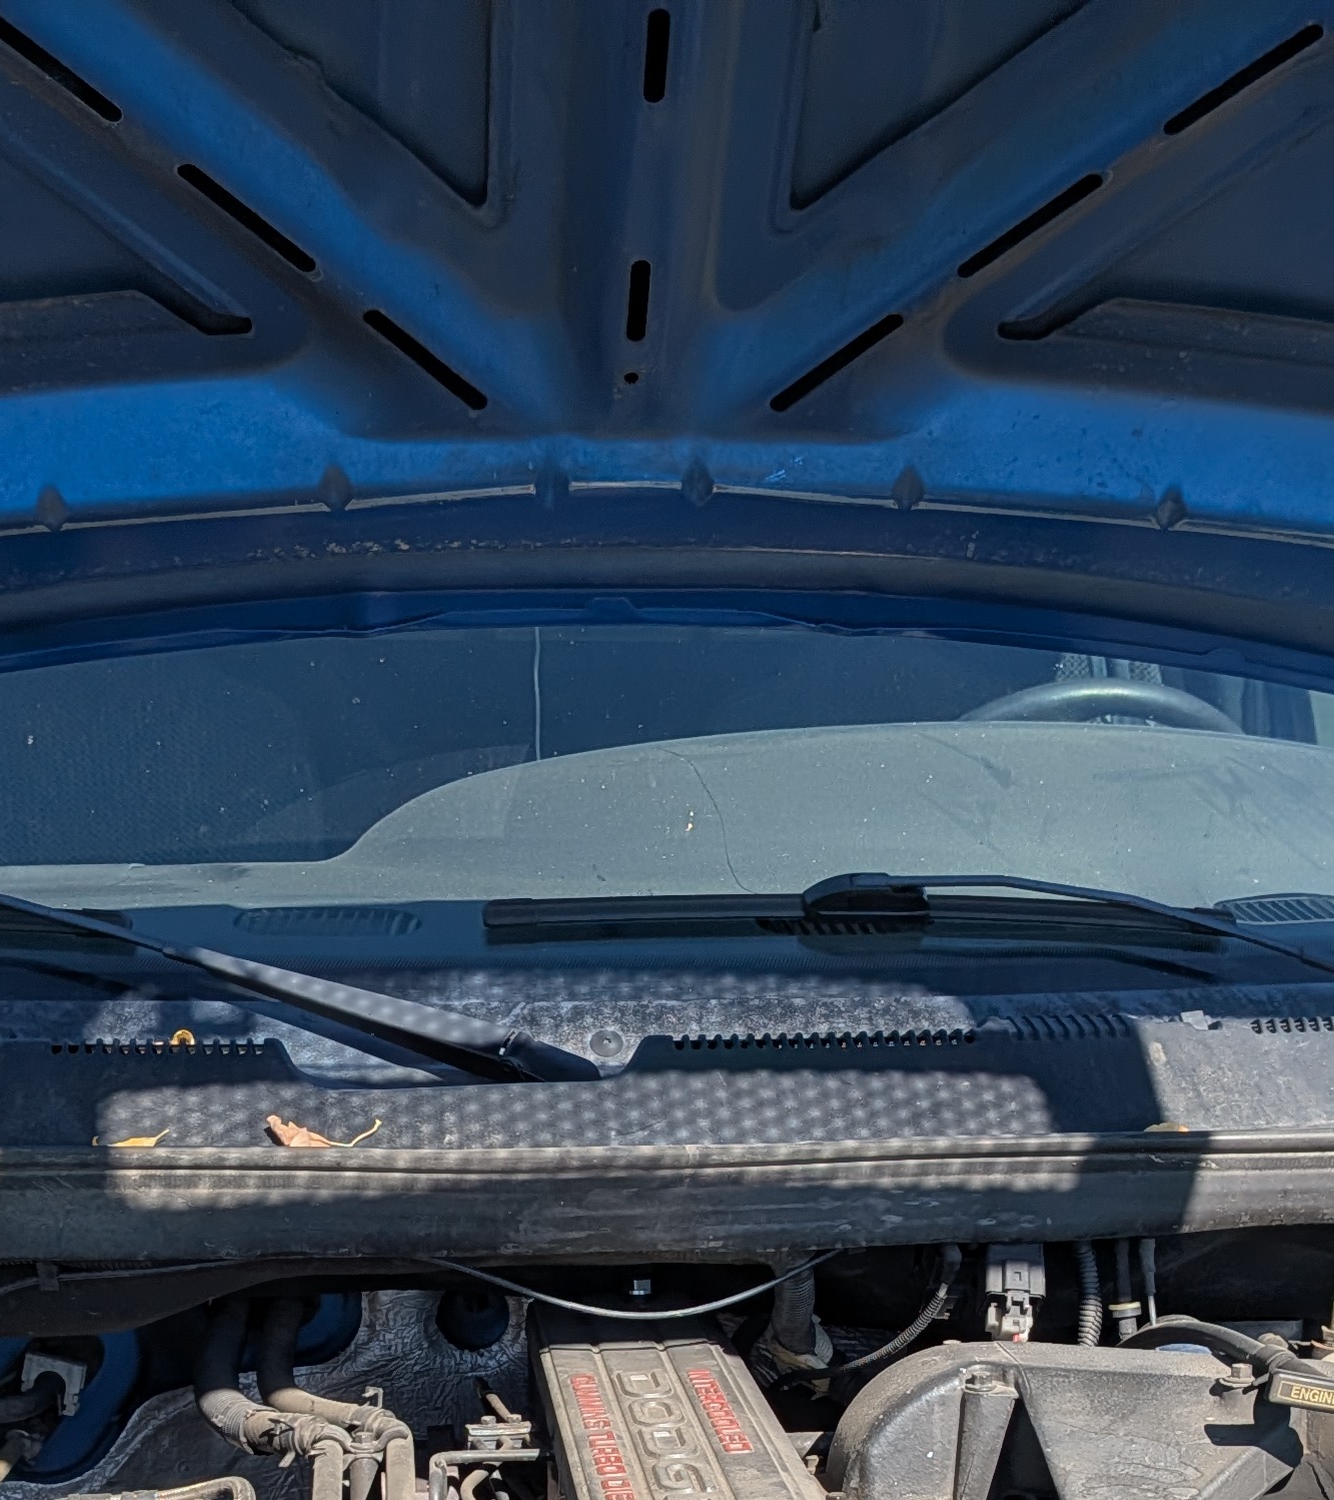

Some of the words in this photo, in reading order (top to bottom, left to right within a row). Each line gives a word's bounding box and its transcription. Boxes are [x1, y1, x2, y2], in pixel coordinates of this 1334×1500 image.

[569, 1373, 612, 1430] CUMMINS
[686, 1367, 754, 1454] INTERCOOLED
[587, 1431, 627, 1477] TURBO
